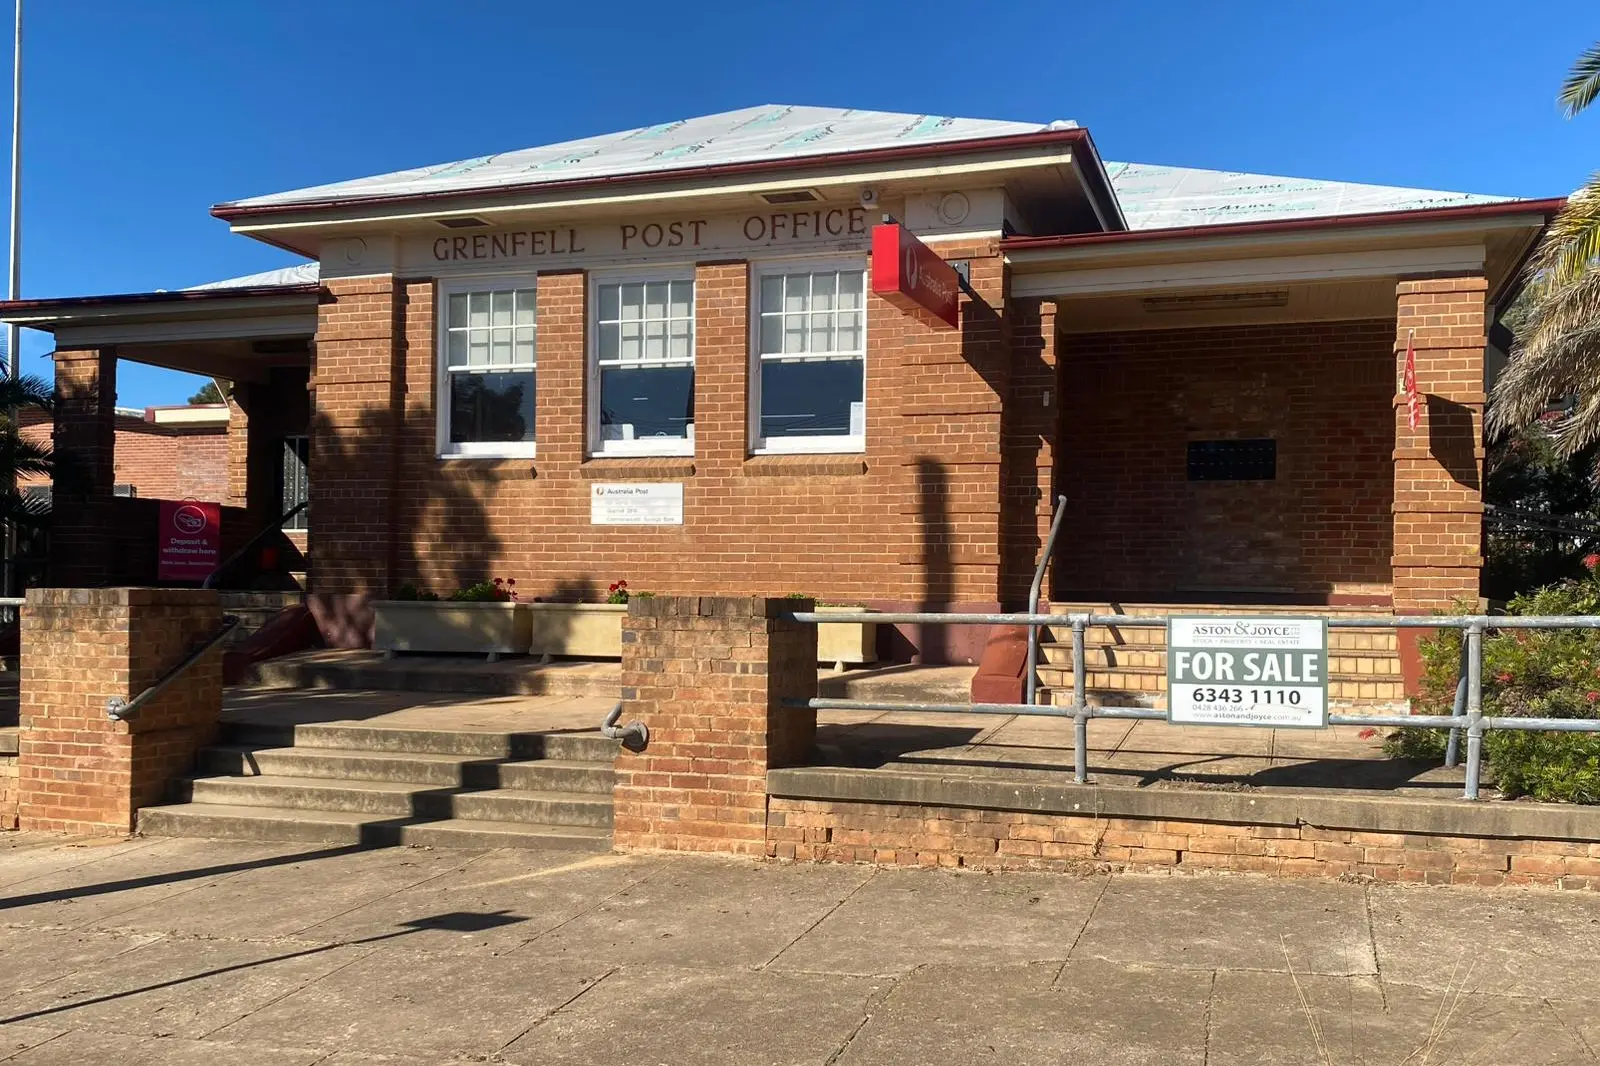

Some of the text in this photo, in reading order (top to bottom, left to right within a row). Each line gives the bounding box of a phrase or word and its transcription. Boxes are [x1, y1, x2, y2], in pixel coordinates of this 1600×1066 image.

[432, 207, 868, 261] GRENFELL POST OFFICE
[607, 487, 649, 495] Australia Post
[1192, 626, 1231, 635] ASTON
[1234, 621, 1250, 636] &
[1250, 626, 1290, 636] JOYCE
[1175, 651, 1319, 682] FOR SALE
[1192, 688, 1301, 705] 6343 1110
[1192, 712, 1302, 721] www.astonandjoyce.com.au
